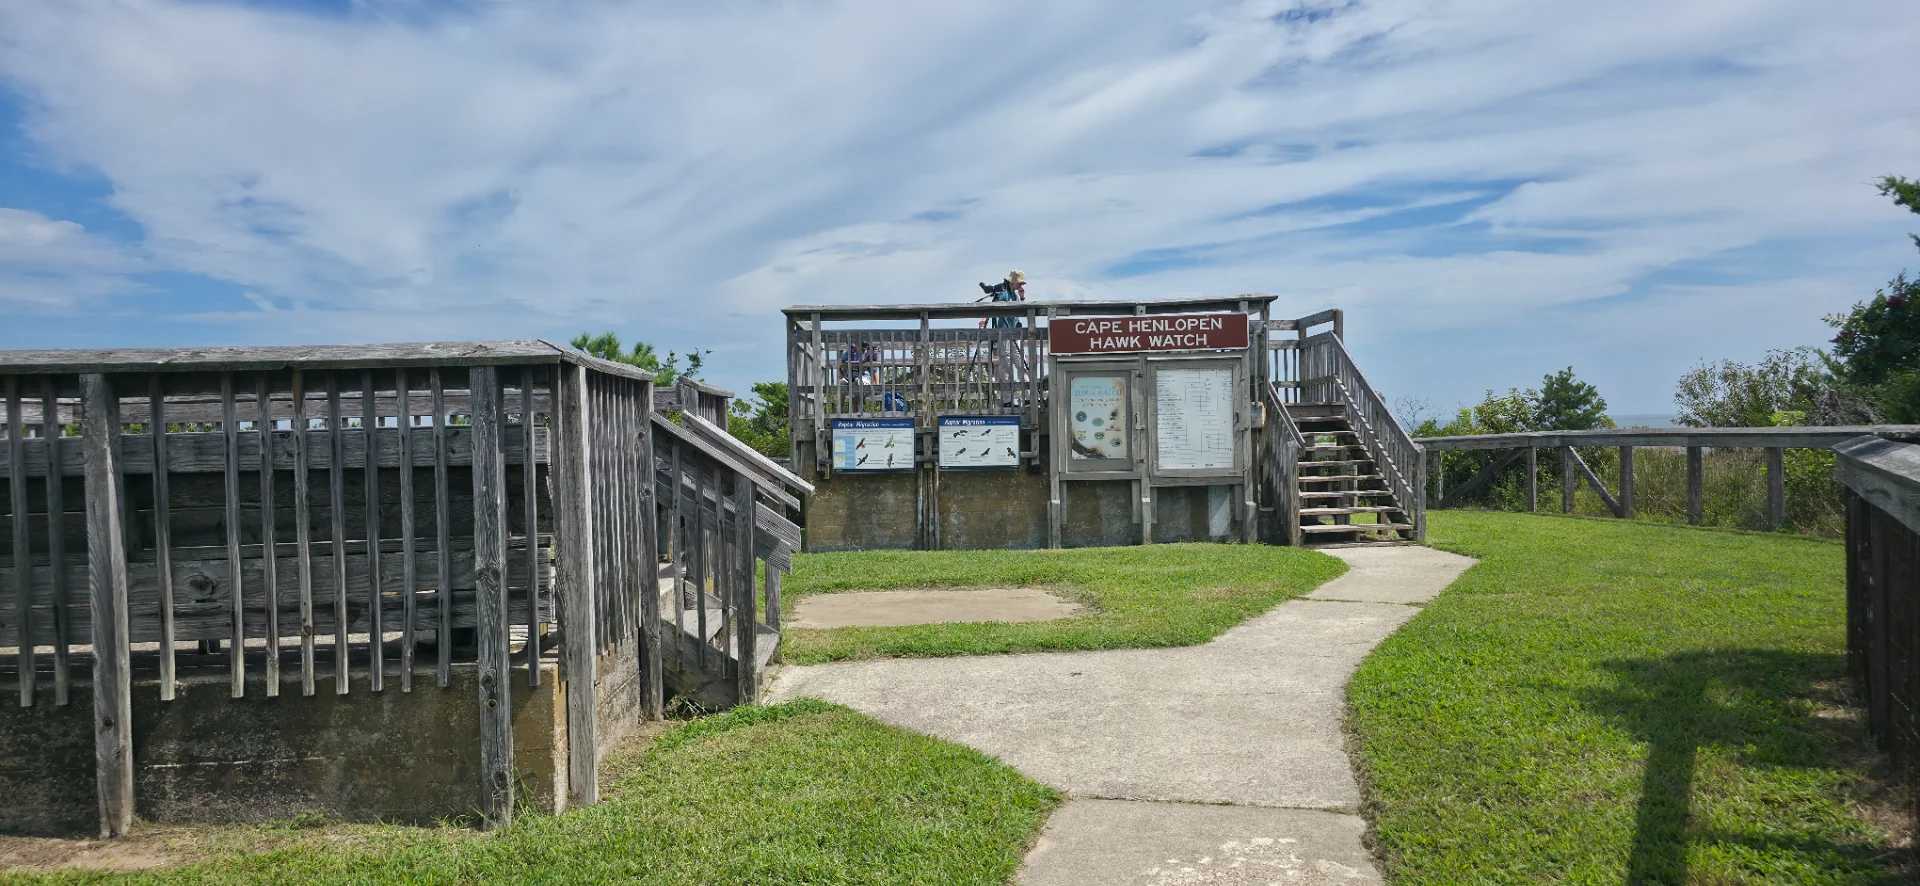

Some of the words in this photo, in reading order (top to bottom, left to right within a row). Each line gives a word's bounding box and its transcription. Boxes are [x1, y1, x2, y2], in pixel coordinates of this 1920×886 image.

[1075, 320, 1122, 334] CAPE
[1128, 318, 1223, 332] HENLOPEN
[1090, 336, 1141, 349] HAWK
[1148, 334, 1208, 348] WATCH
